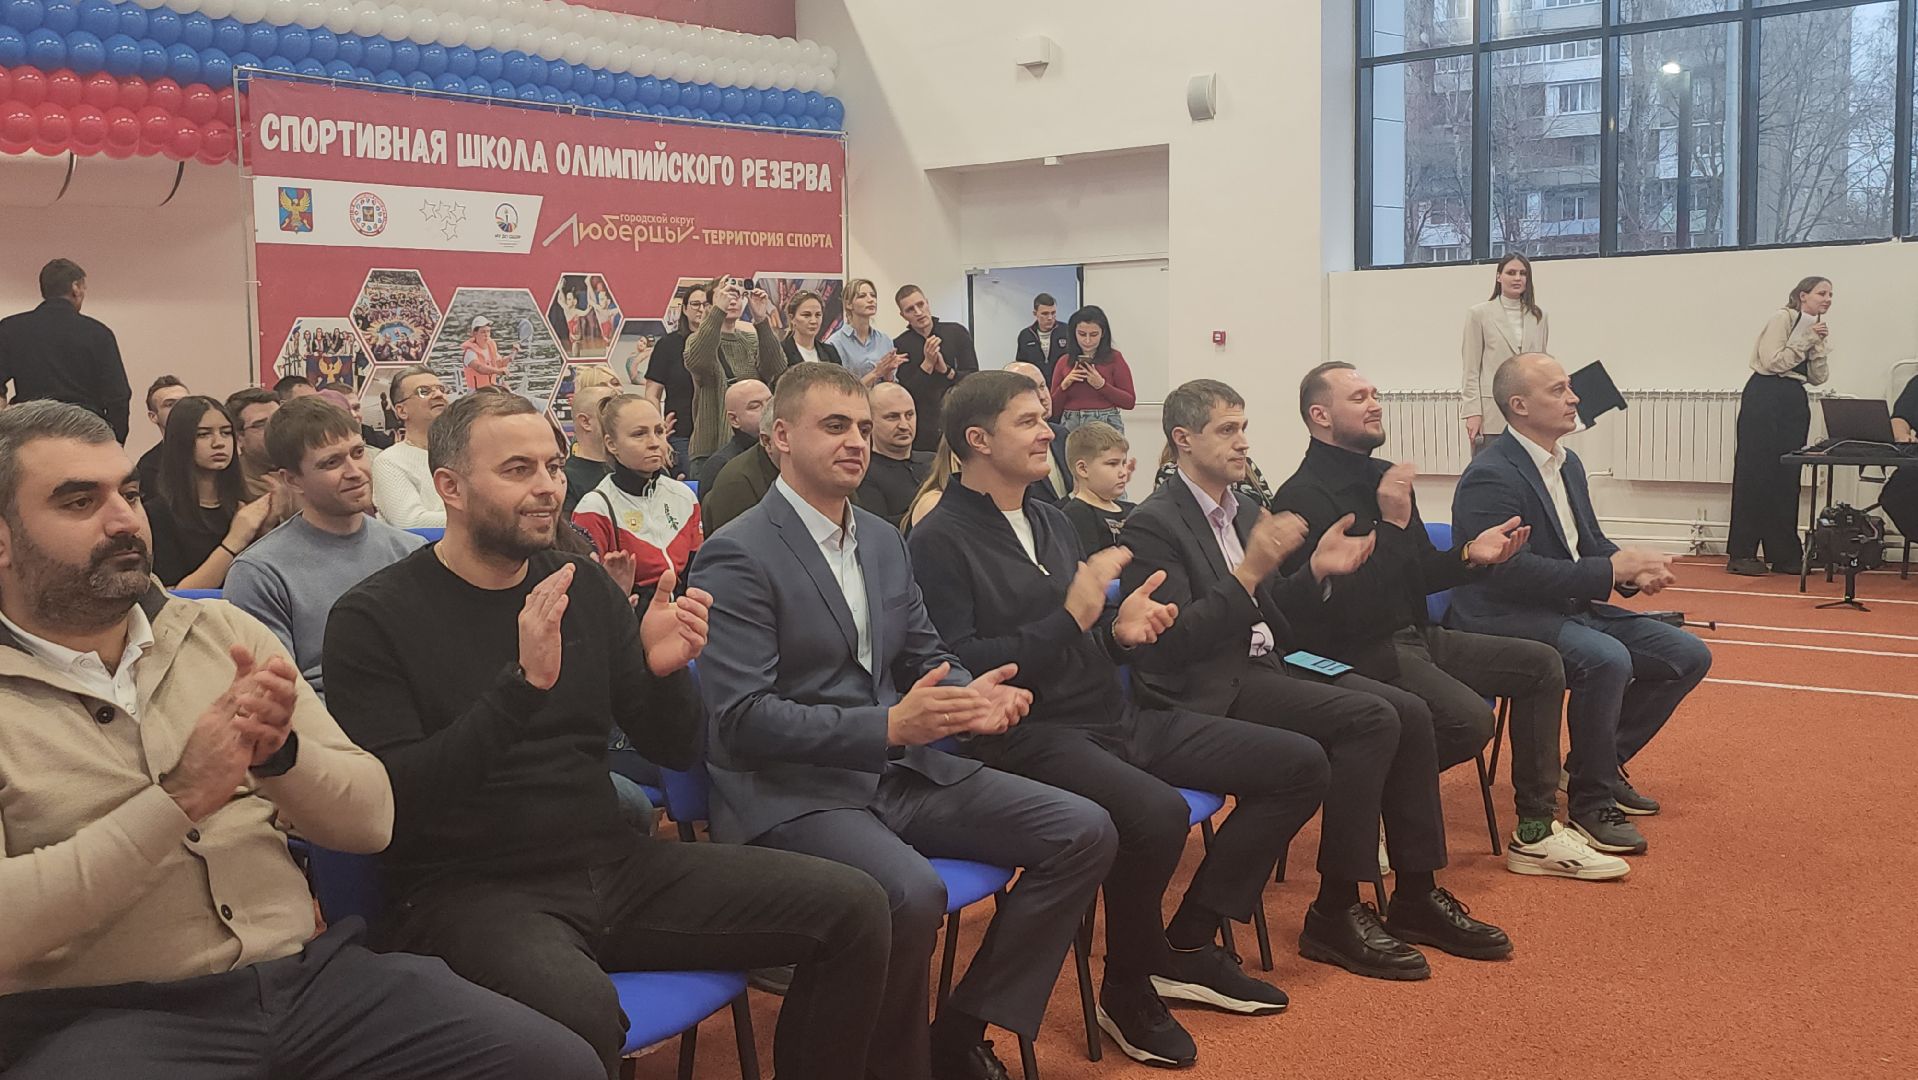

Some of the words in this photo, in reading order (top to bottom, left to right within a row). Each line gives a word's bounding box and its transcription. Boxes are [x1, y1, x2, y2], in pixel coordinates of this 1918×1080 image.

[260, 113, 447, 165] СПОРТИВНАЯ
[457, 133, 549, 173] ШКОЛА
[556, 141, 735, 186] ОЛИМПИЙСКОГО
[741, 158, 832, 193] РЕЗЕРВА
[620, 213, 668, 224] городской
[670, 216, 695, 227] округ
[702, 229, 784, 247] ТЕРРИТОРИЯ
[786, 232, 834, 249] СПОРТА
